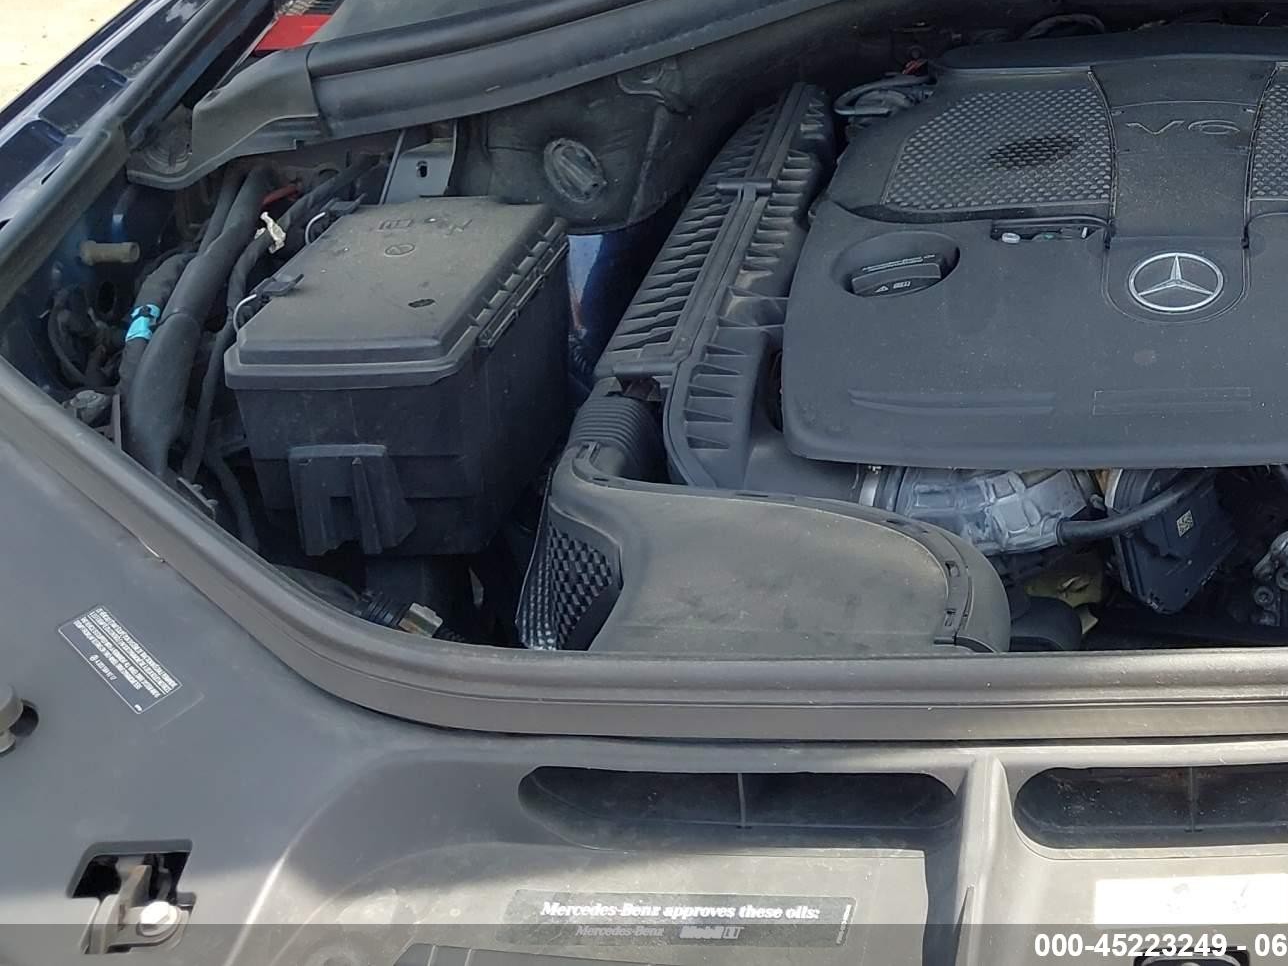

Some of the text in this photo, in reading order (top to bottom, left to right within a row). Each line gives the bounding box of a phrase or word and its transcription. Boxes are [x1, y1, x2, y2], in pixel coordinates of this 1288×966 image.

[1126, 119, 1240, 135] V6
[540, 901, 820, 919] Mercedes-Benz approves these oils:
[575, 925, 665, 937] Mercedes-Benz
